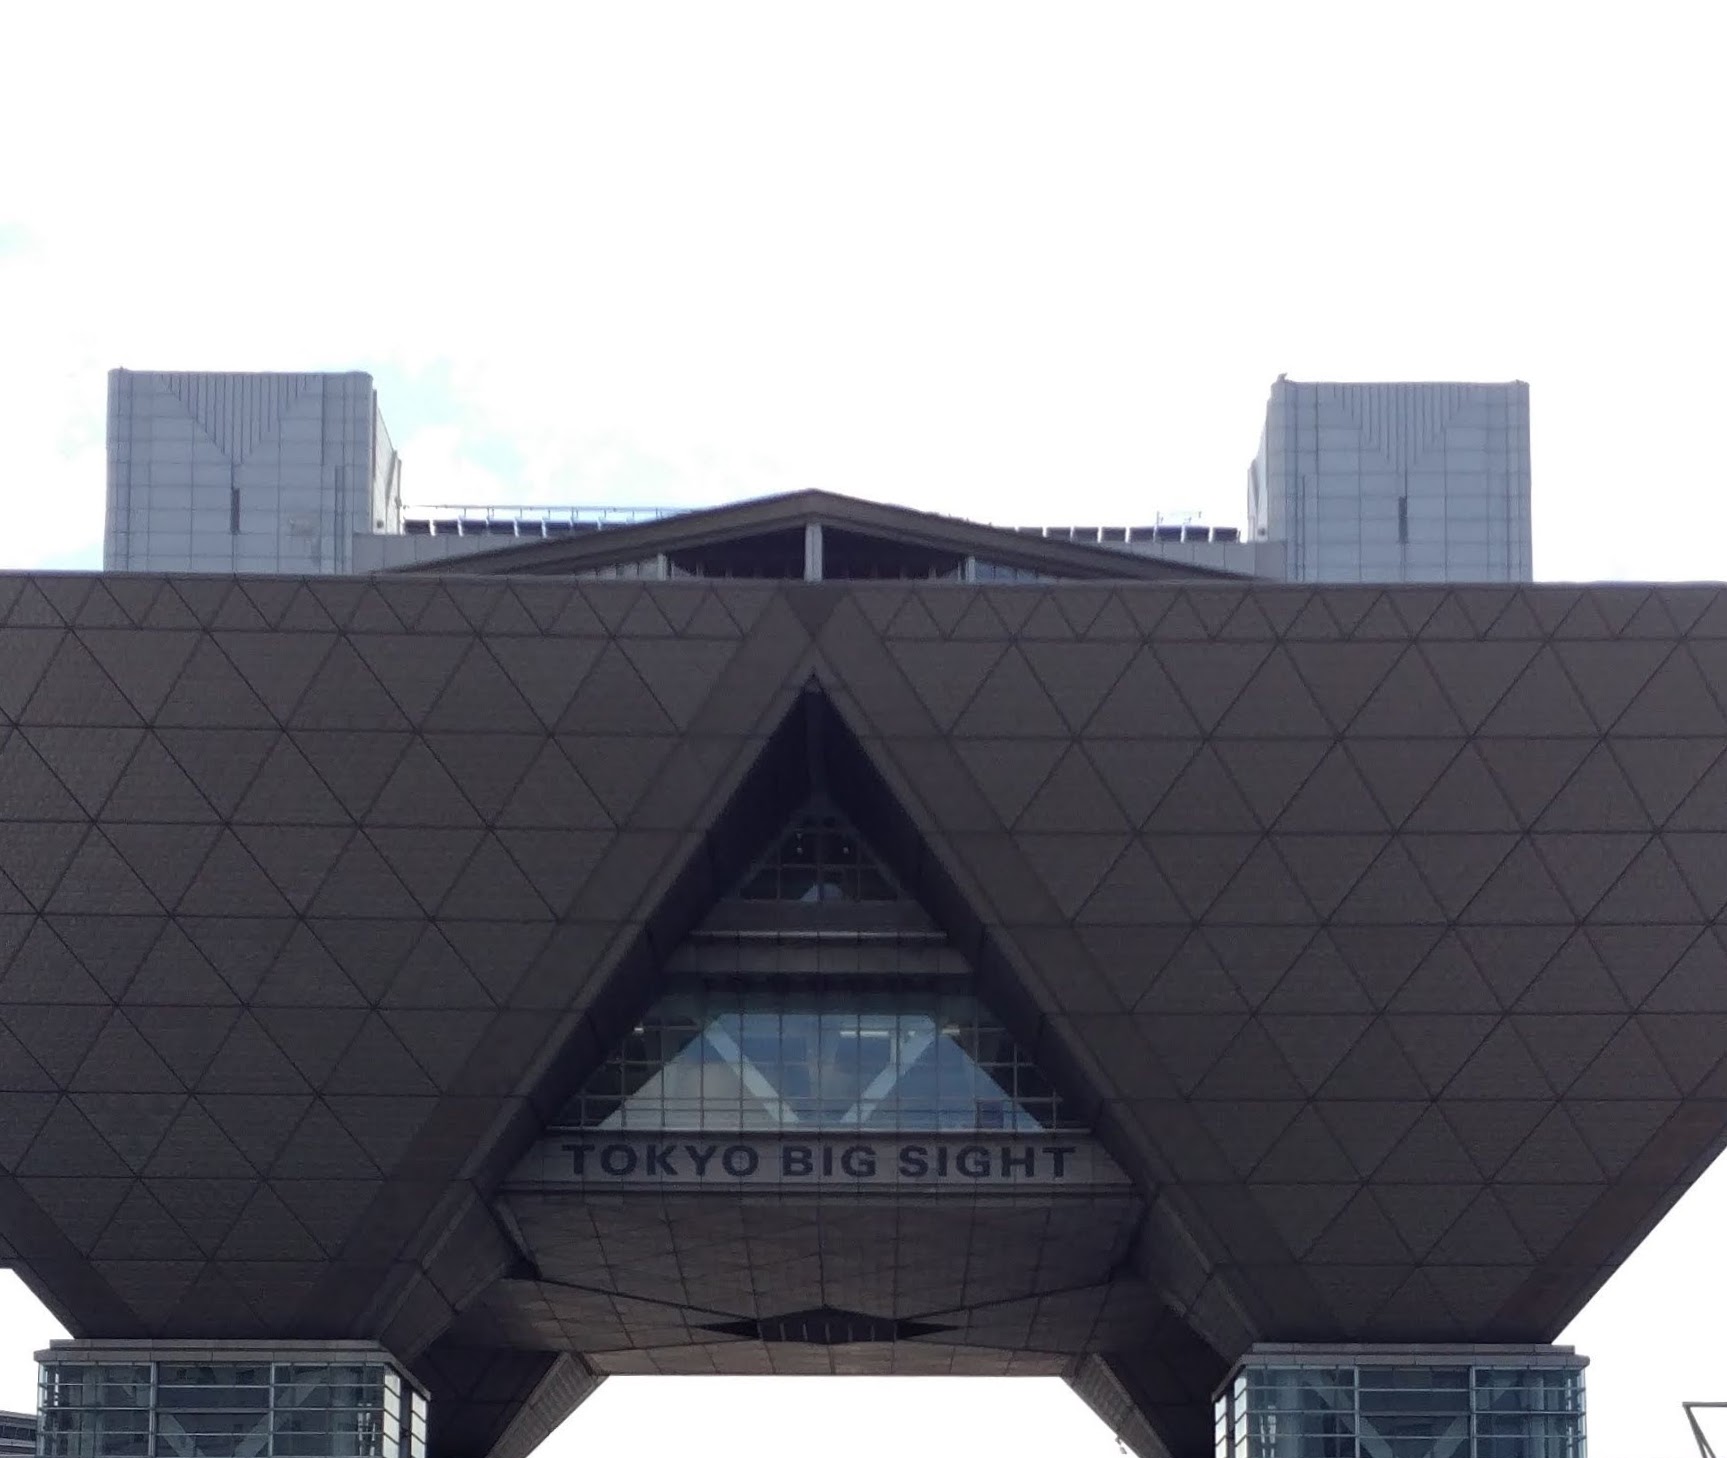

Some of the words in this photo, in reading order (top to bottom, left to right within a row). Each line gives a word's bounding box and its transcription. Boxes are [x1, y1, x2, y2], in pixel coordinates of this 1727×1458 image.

[562, 1144, 759, 1176] TOKYO
[782, 1145, 877, 1177] BIG
[898, 1145, 1077, 1178] SIGHT
